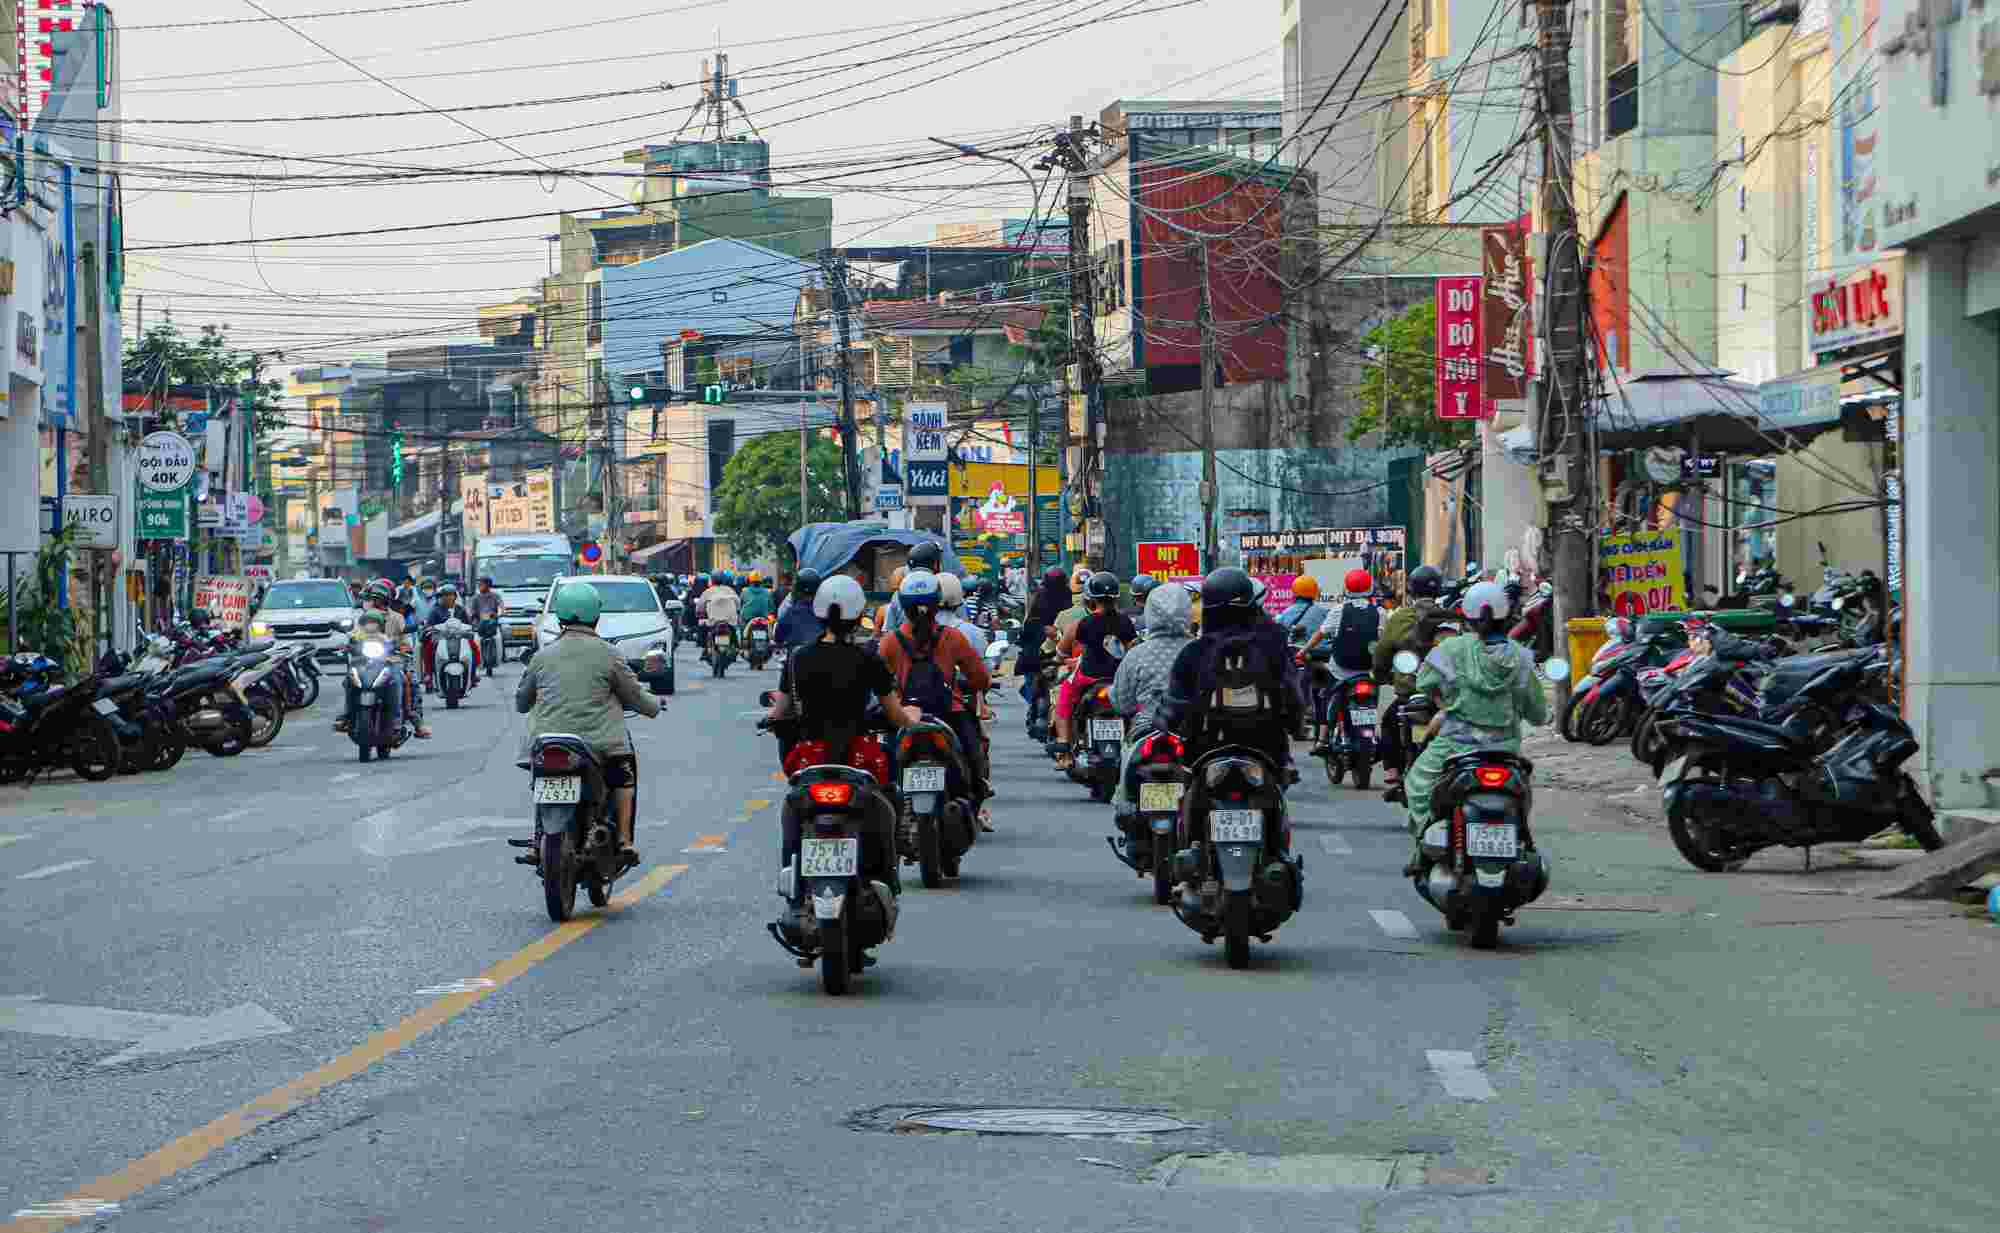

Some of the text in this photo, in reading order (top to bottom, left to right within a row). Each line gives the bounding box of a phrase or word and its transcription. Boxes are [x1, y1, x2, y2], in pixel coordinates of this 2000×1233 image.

[1453, 391, 1469, 415] Y
[151, 471, 178, 485] 40K
[910, 468, 947, 488] Yuki
[67, 507, 113, 523] MIRO
